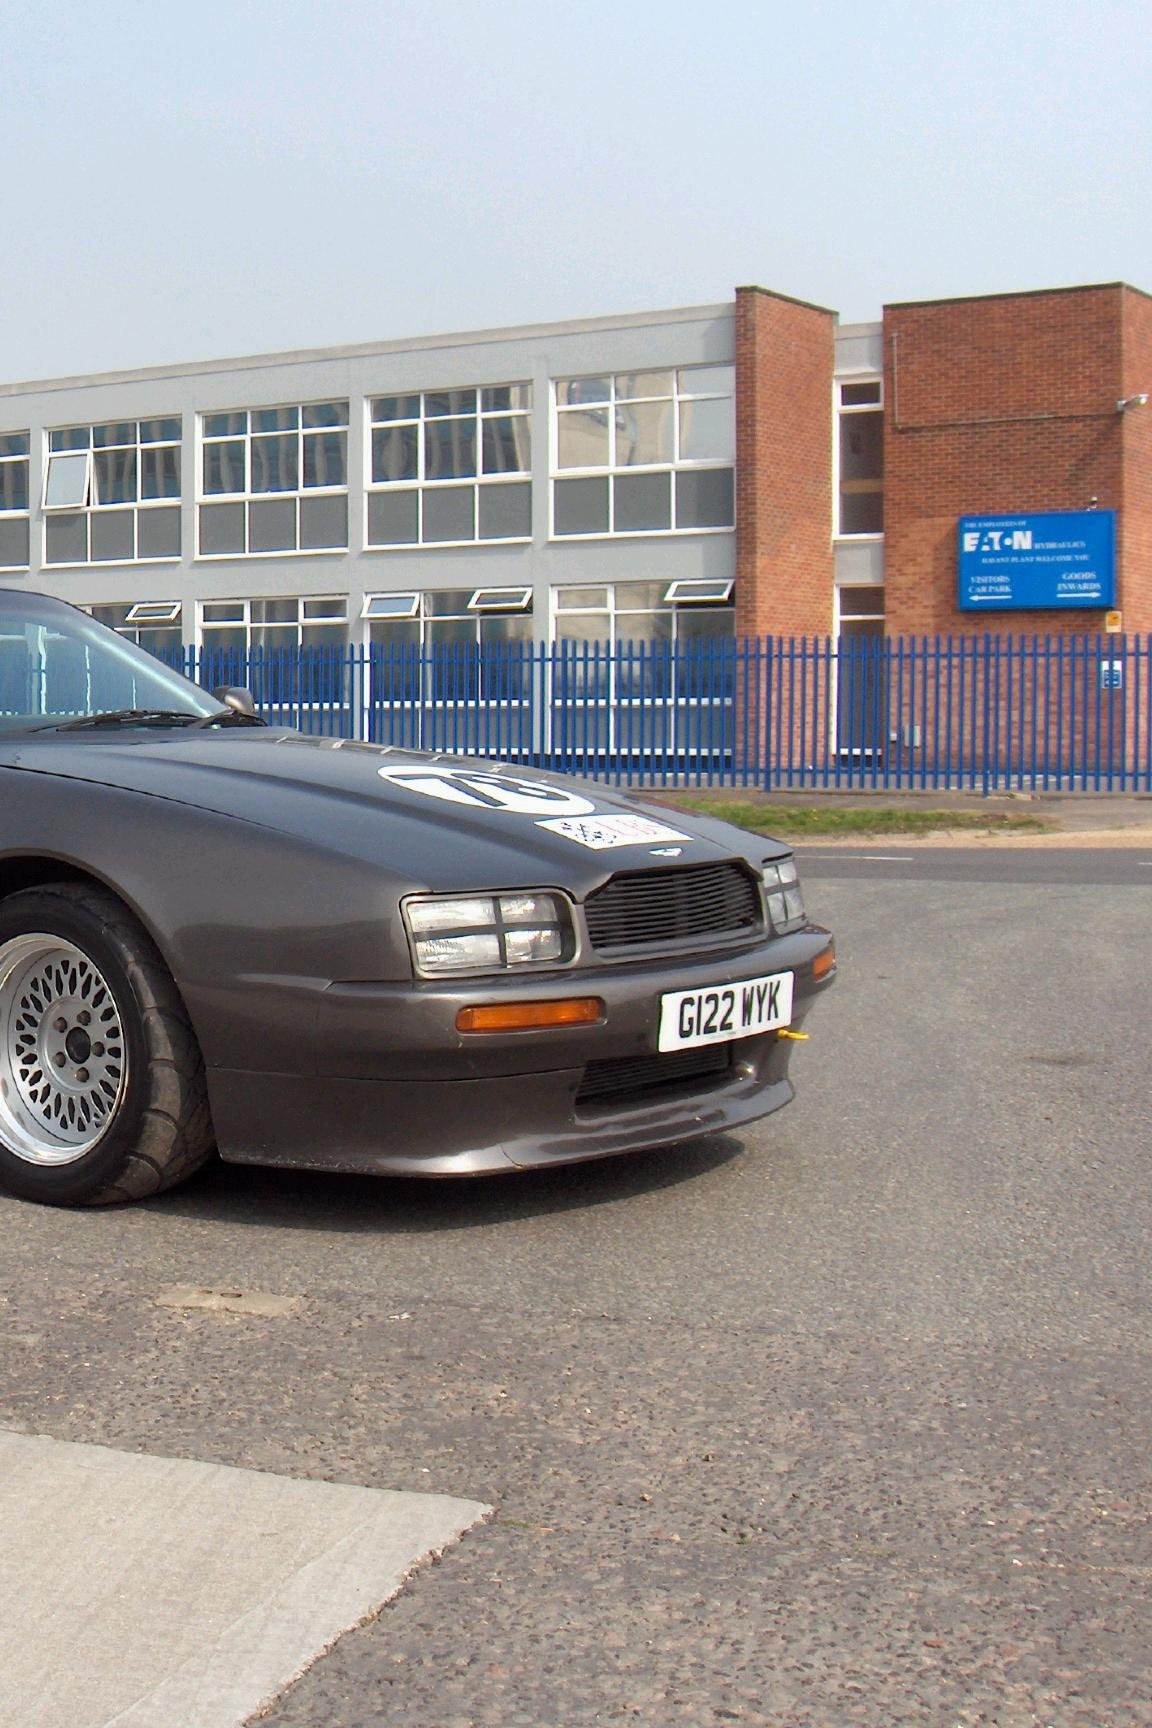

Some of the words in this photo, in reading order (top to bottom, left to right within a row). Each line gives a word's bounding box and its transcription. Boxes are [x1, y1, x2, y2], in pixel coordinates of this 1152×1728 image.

[962, 530, 1033, 552] EATON
[1034, 541, 1087, 550] HYDRAULICS
[970, 575, 1011, 584] VISITORS
[1061, 571, 1097, 580] GOODS
[988, 585, 1012, 593] PARK
[1056, 582, 1102, 591] INWARDS
[388, 772, 571, 808] 78
[678, 990, 735, 1039] G122
[742, 980, 781, 1027] WYK
